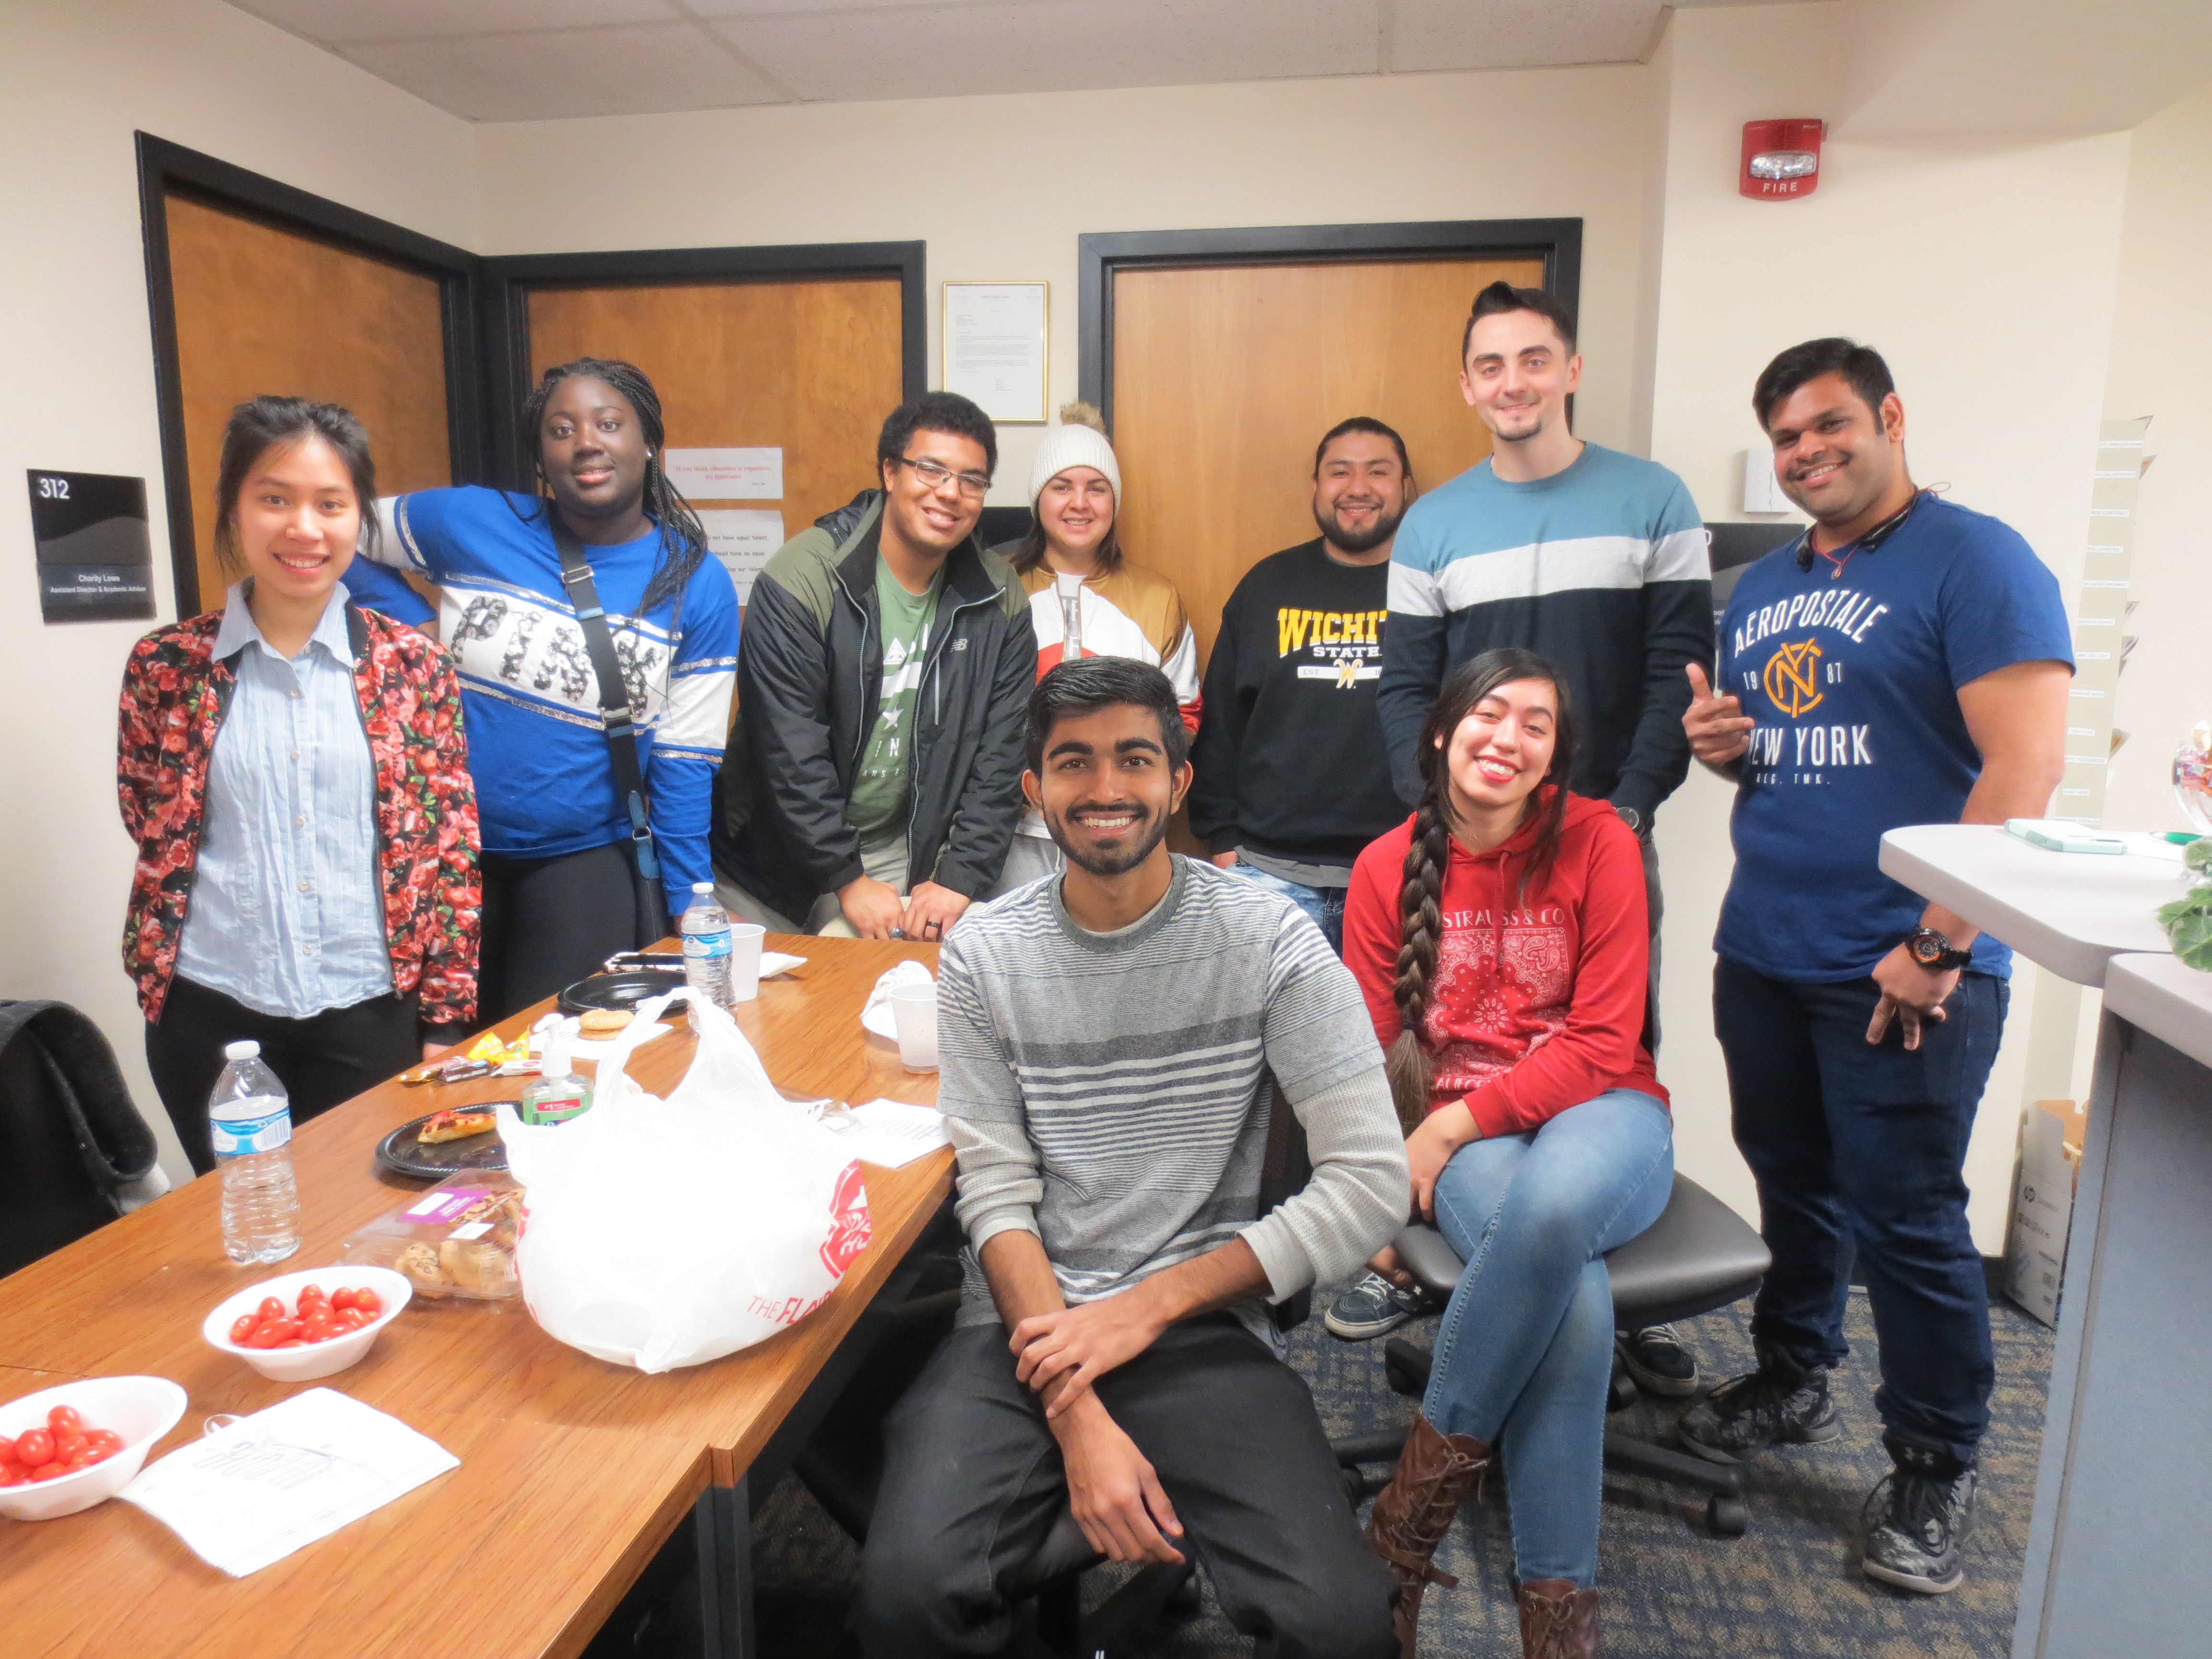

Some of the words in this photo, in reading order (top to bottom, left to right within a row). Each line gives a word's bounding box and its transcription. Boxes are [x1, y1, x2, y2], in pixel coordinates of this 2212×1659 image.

[1763, 182, 1798, 193] FIRE
[38, 478, 70, 500] 312
[78, 574, 101, 584] Charity
[1313, 646, 1380, 658] STATE
[1743, 671, 1758, 690] 19
[1827, 662, 1841, 684] 87
[1795, 724, 1872, 766] YORK
[1523, 909, 1534, 926] &
[1541, 907, 1565, 925] CO
[747, 1295, 781, 1319] THE
